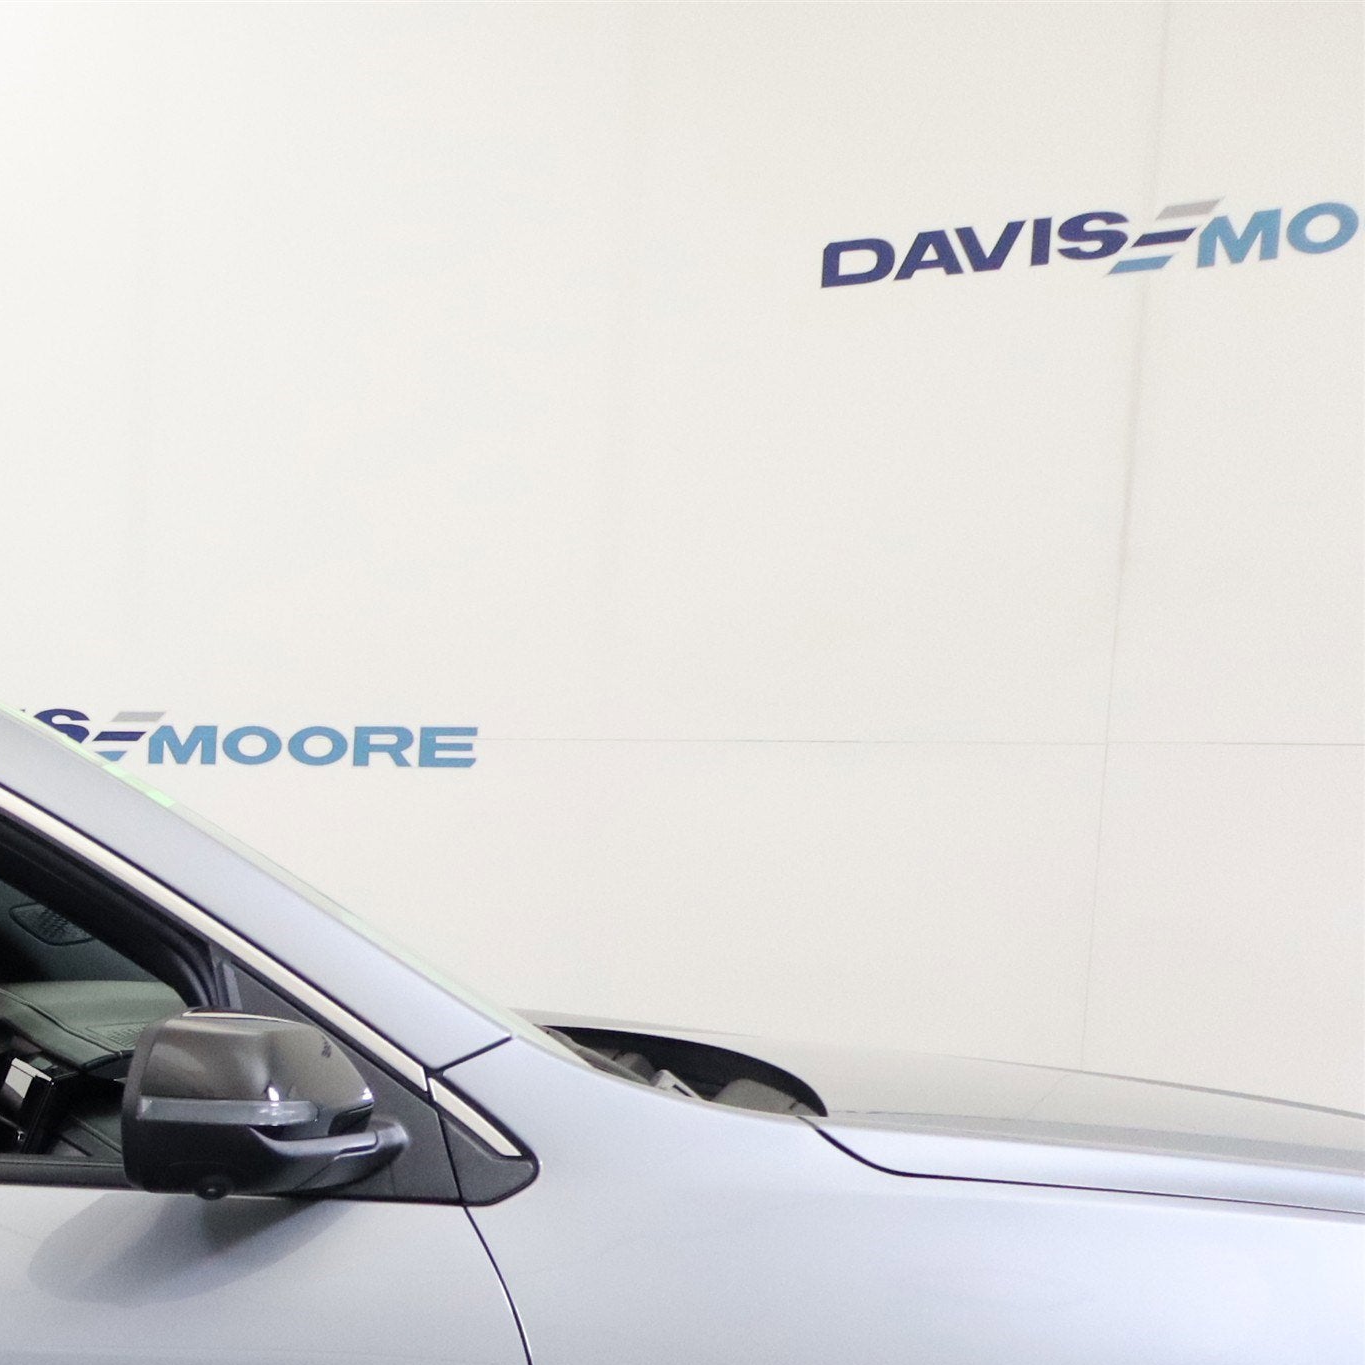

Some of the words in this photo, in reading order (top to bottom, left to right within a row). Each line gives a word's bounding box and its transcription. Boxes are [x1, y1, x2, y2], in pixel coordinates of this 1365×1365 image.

[820, 210, 1130, 289] DAVIS
[1195, 201, 1365, 269] MO
[147, 724, 479, 769] MOORE
